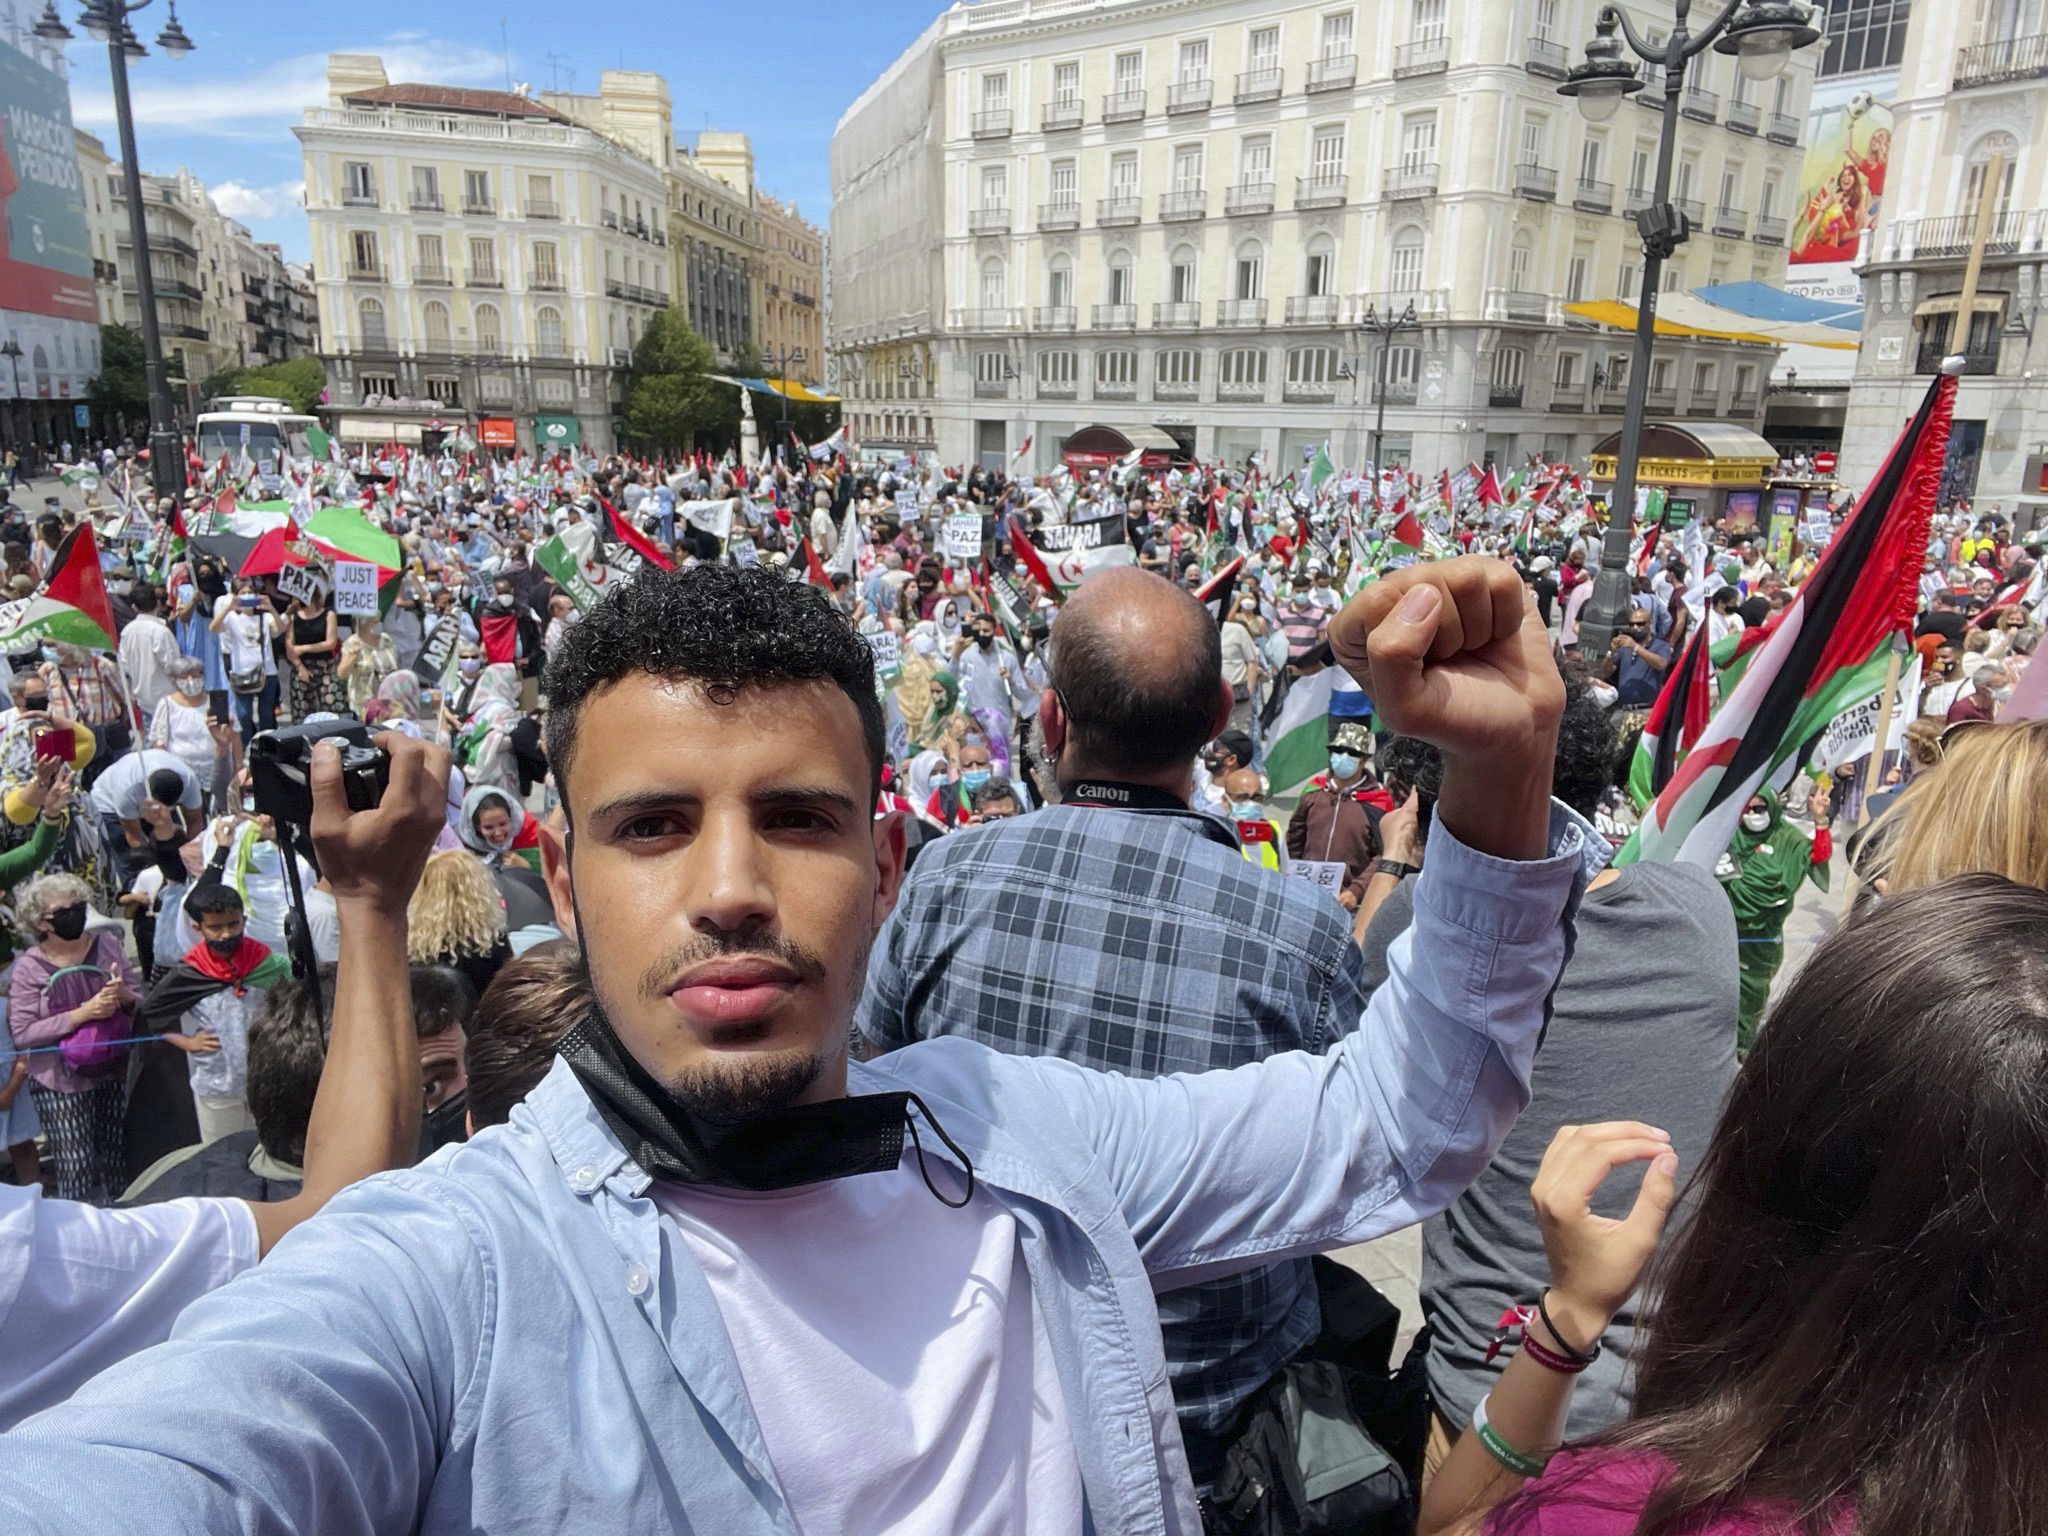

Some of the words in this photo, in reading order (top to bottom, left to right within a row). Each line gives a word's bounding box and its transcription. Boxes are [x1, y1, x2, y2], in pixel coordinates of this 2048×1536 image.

[17, 141, 77, 191] PERDIDO
[1812, 287, 1835, 297] Pro
[1651, 465, 1688, 480] TICKETS
[951, 530, 980, 543] PAZ
[1044, 522, 1101, 550] SAHARA
[282, 564, 314, 595] PAZ
[341, 566, 373, 584] JUST
[338, 591, 377, 610] PEACE!
[1075, 783, 1130, 802] Canon
